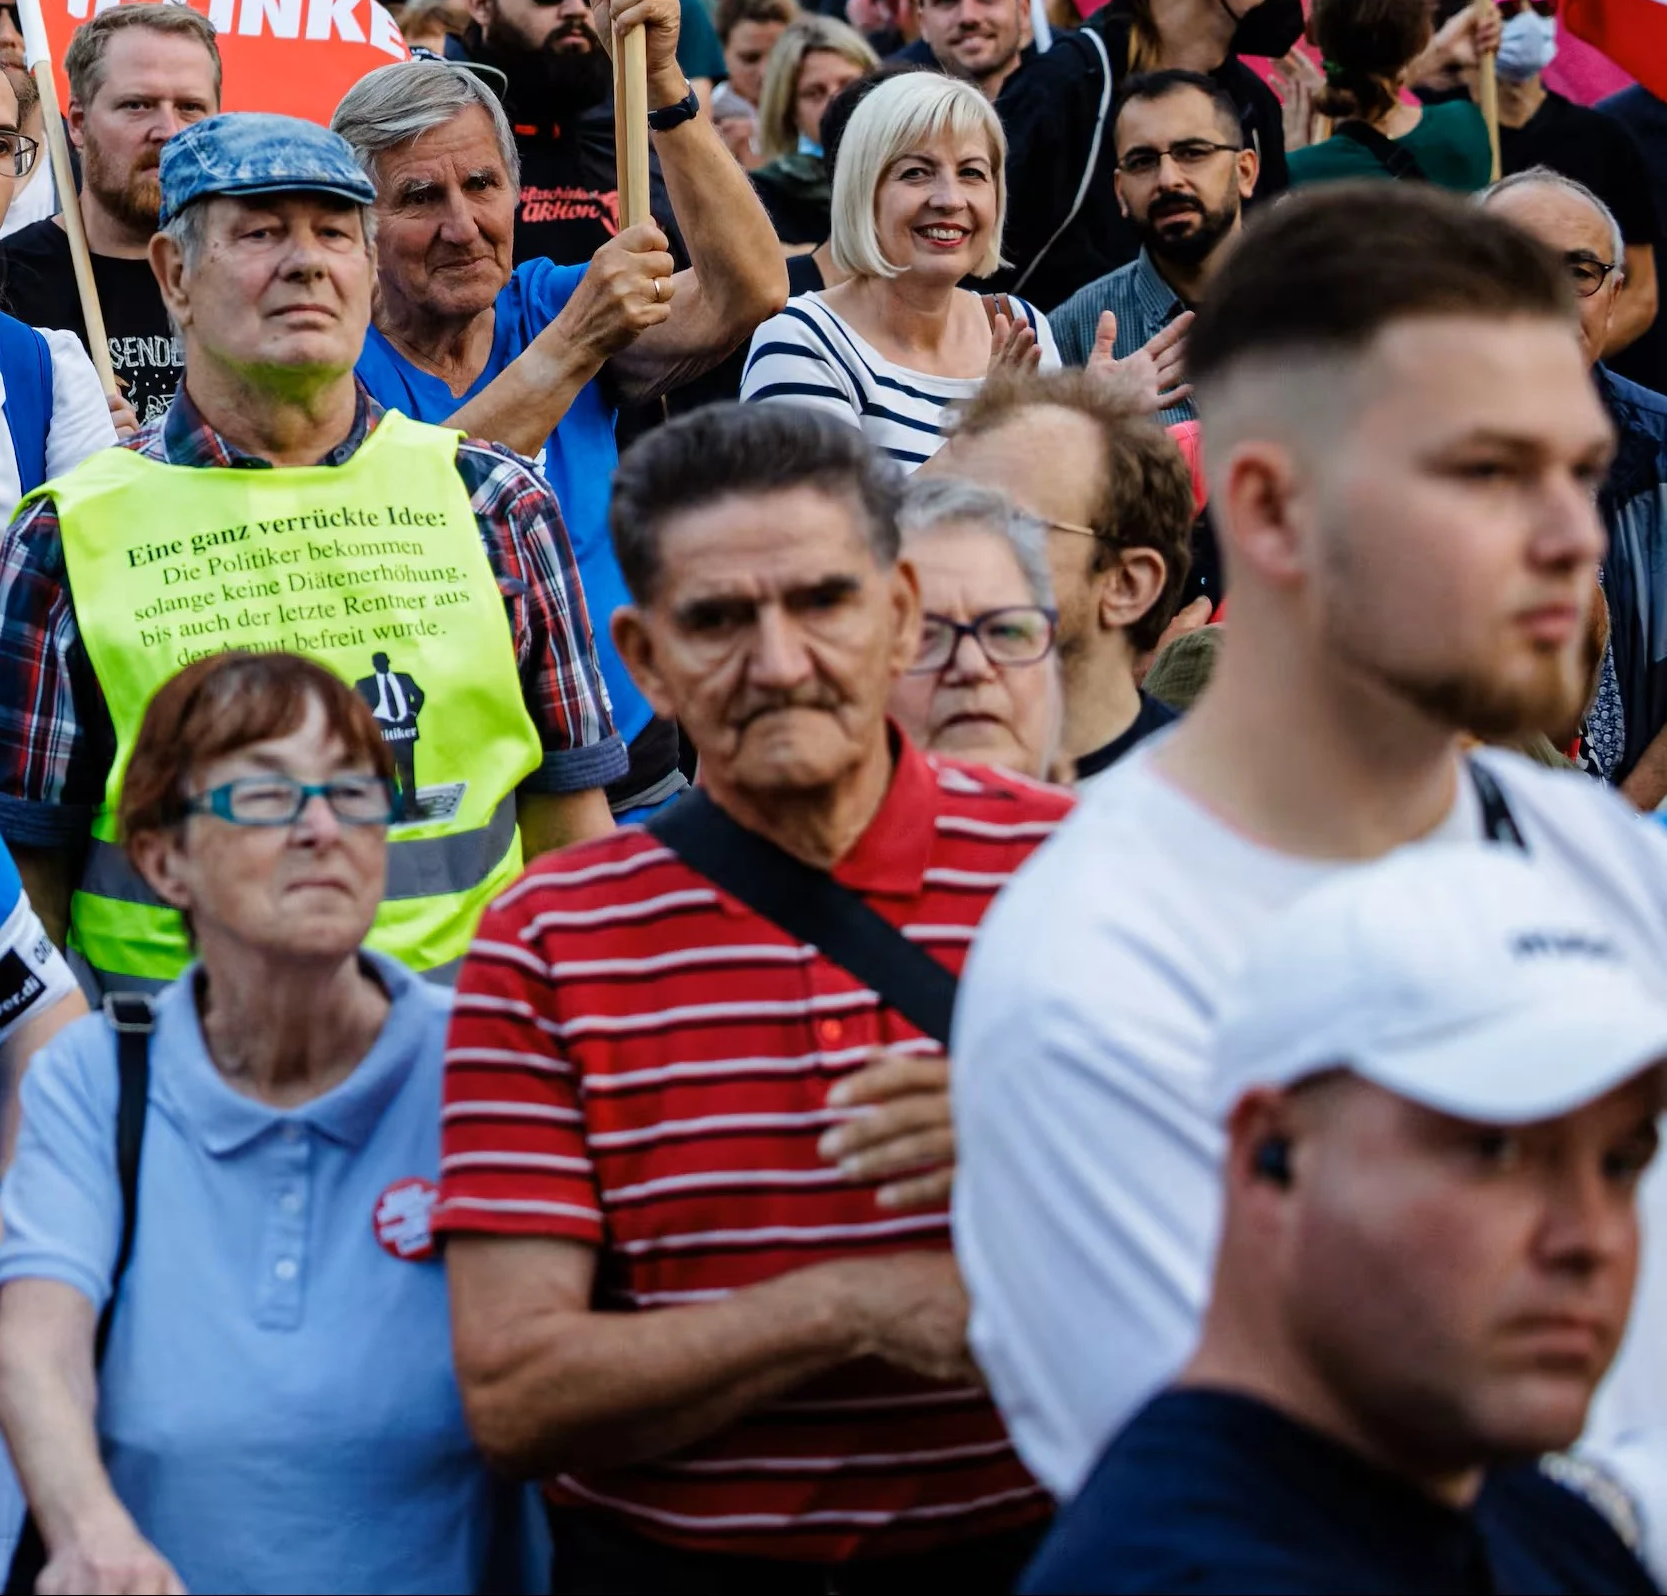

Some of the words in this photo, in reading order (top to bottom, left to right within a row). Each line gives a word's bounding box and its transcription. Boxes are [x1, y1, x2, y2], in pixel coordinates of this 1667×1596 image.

[126, 539, 183, 568] Eine
[190, 524, 252, 556] ganz
[257, 506, 379, 536] verrückte
[386, 505, 447, 527] Idee:
[162, 562, 202, 586] Die
[207, 546, 302, 577] Politiker
[307, 538, 425, 561] bekommen
[133, 590, 217, 623] solange
[221, 578, 281, 603] keine
[139, 624, 172, 648] bis
[178, 613, 230, 638] auch
[236, 608, 272, 629] der
[277, 601, 337, 624] letzte
[343, 592, 429, 617] Rentner
[433, 589, 471, 608] aus
[176, 646, 213, 668] der
[294, 625, 366, 652] befreit
[372, 619, 448, 641] wurde.
